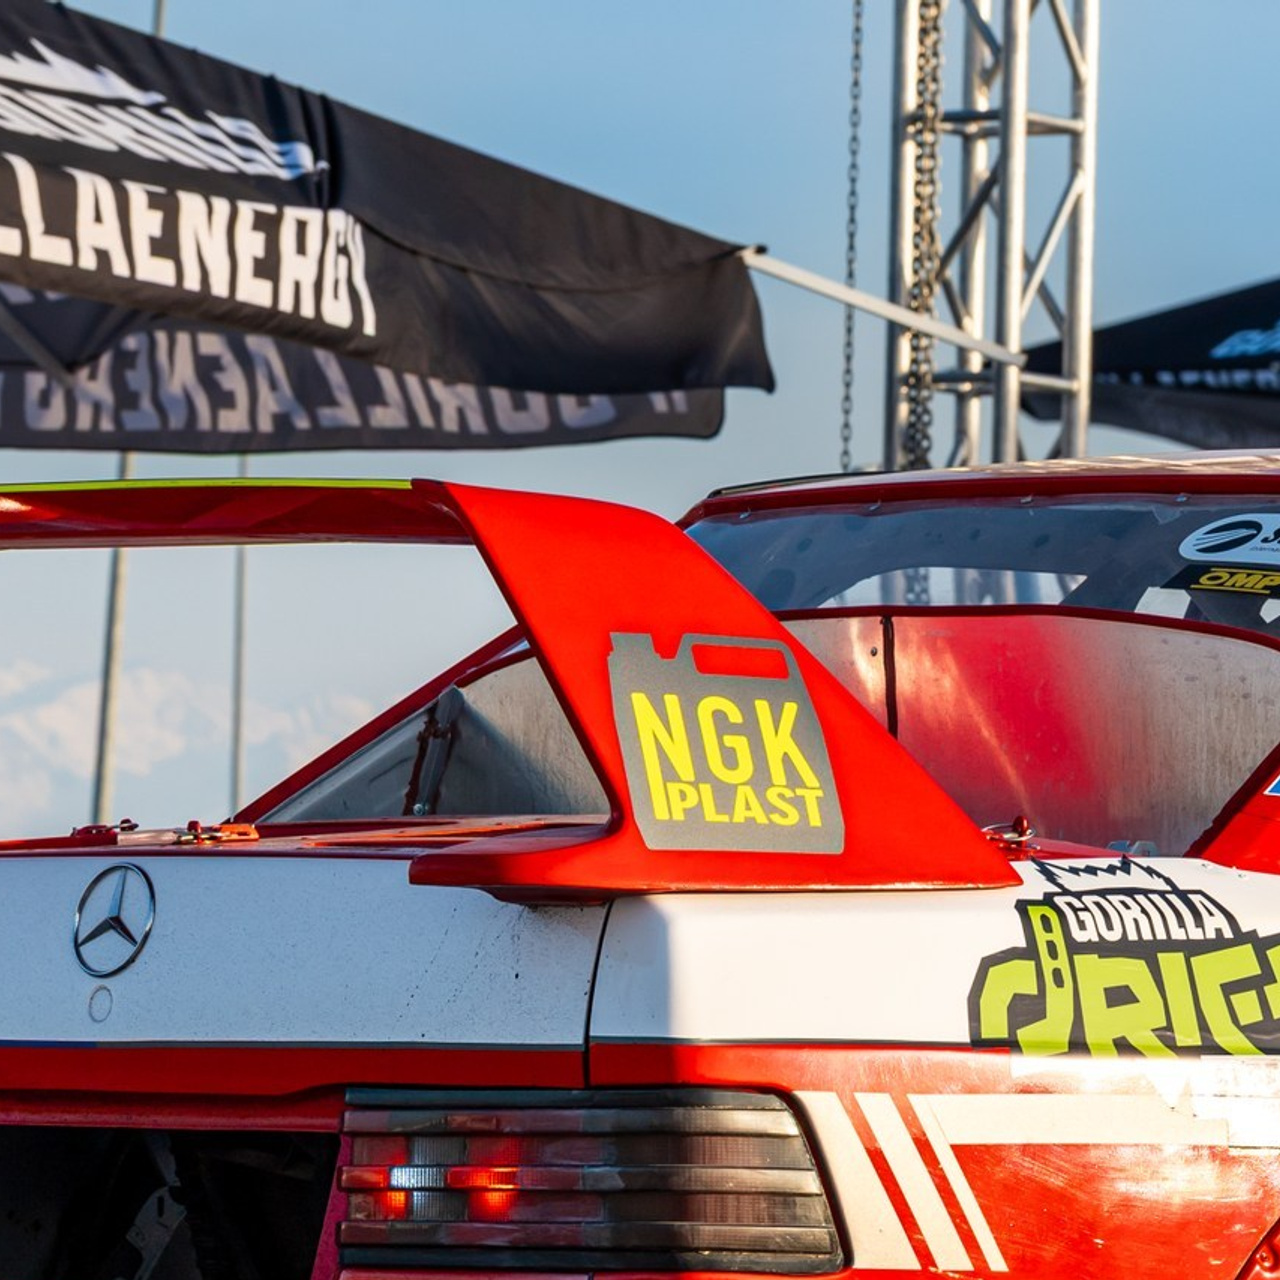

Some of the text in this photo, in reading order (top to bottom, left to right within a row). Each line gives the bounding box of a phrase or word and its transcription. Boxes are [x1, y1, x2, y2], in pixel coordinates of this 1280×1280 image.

[631, 692, 821, 820] NGK
[666, 781, 824, 827] PLAST
[1053, 893, 1235, 943] GORILLA
